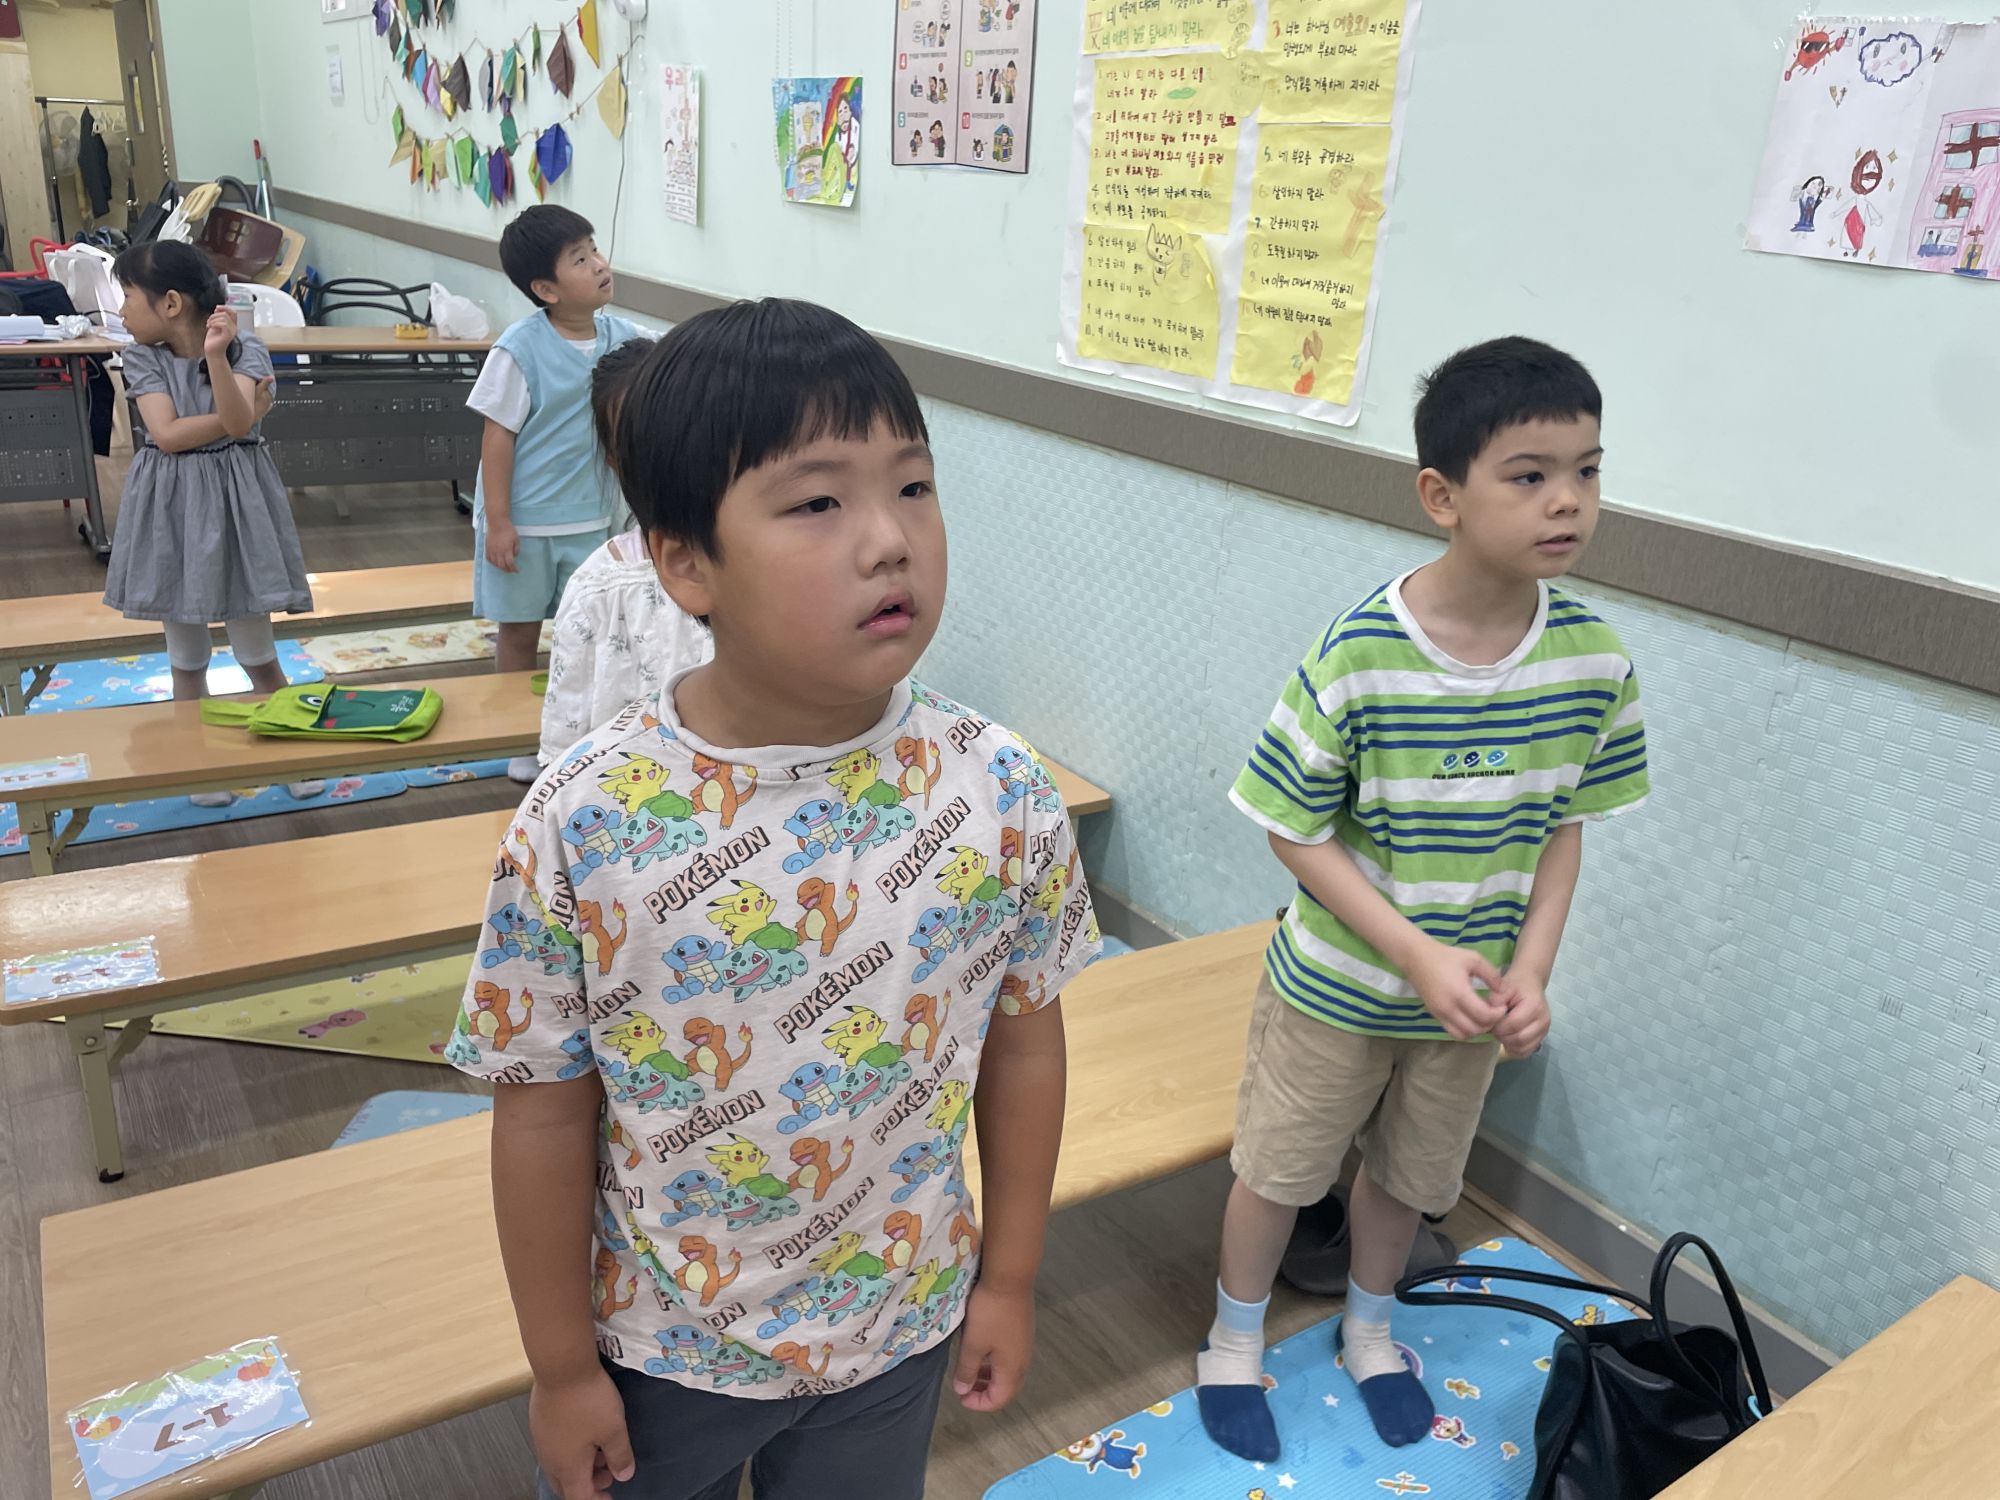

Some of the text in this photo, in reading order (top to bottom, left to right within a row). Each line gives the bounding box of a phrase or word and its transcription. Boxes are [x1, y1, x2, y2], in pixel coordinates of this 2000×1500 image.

[643, 826, 772, 924] POKÉMON
[876, 796, 972, 903] POKÉMON
[774, 940, 894, 1044] POKÉMON
[646, 1089, 766, 1163] POKÉMON
[870, 1035, 960, 1146] POKÉMON
[762, 1176, 875, 1270] POKÉMON
[153, 1402, 234, 1452] 1-7
